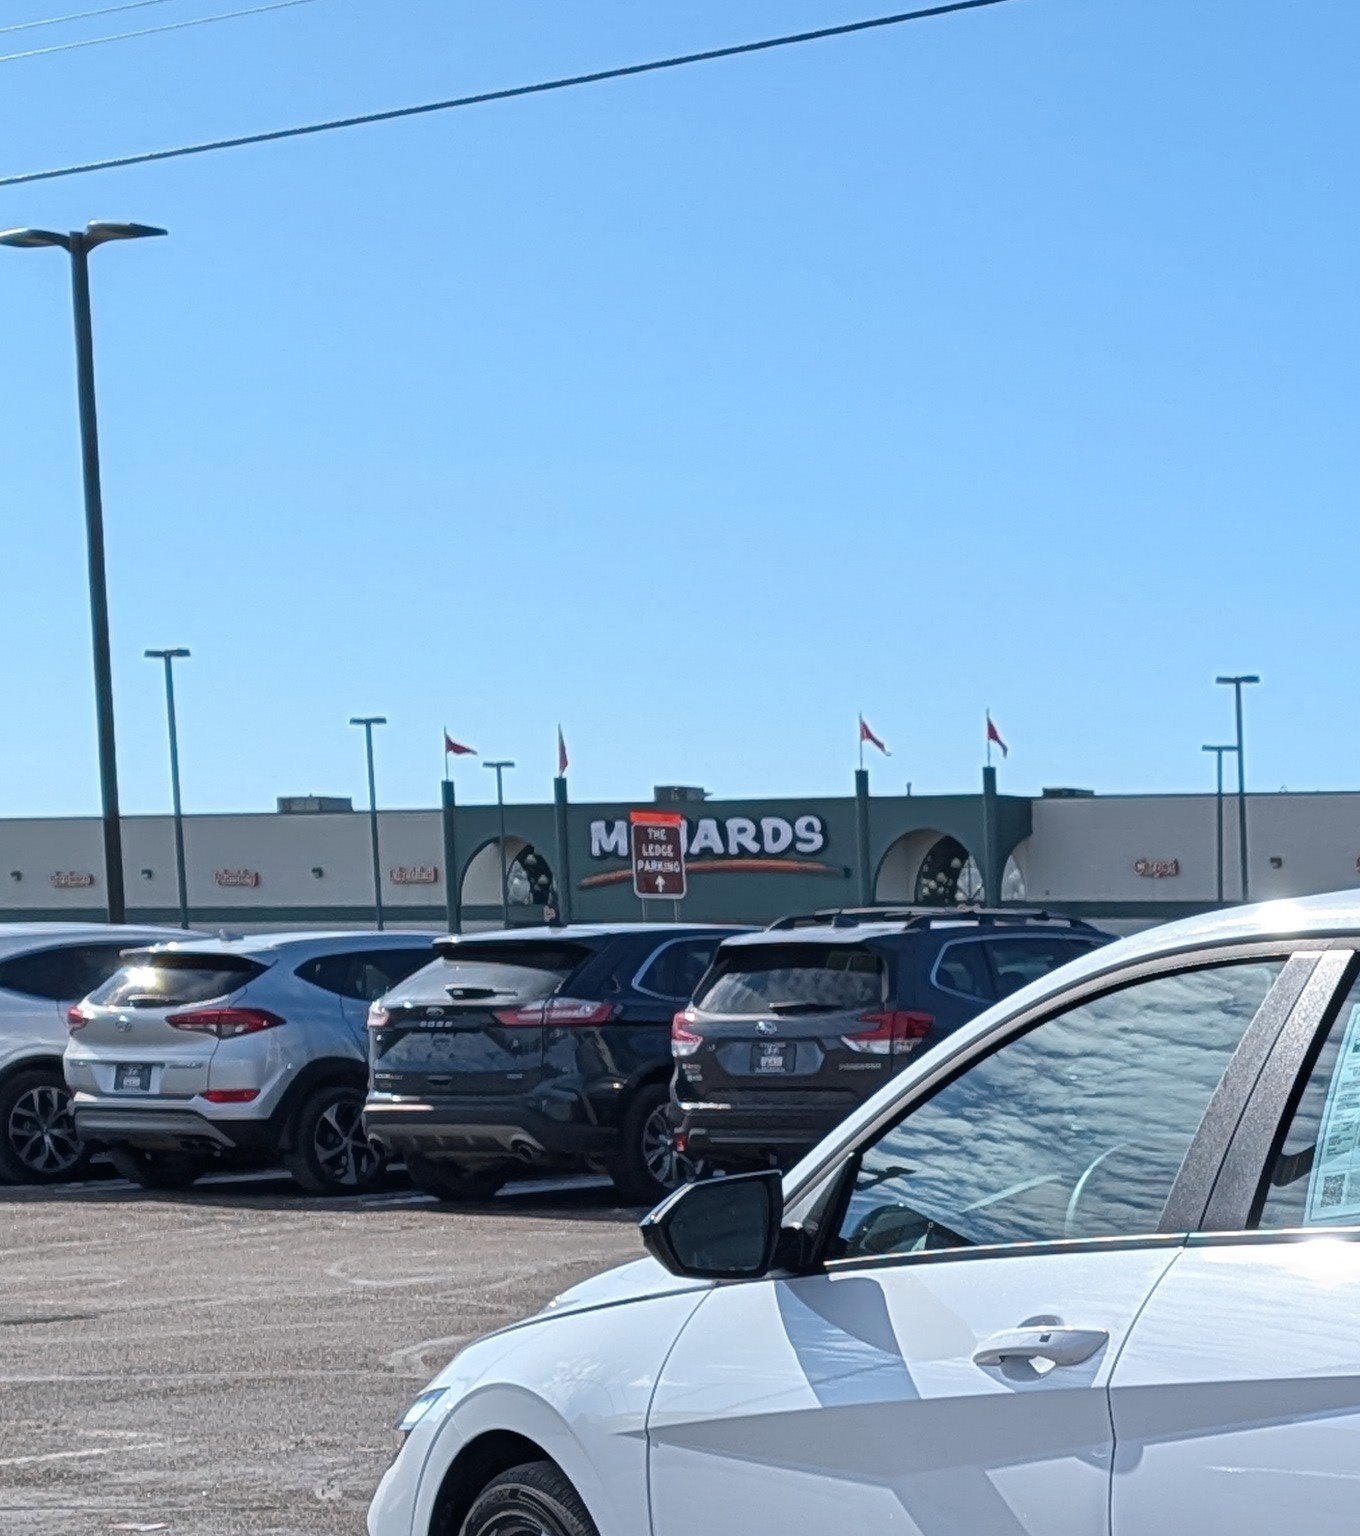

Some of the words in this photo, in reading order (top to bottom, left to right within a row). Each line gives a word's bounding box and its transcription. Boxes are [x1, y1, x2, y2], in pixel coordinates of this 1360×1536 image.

[590, 815, 825, 857] MARDS
[647, 828, 667, 841] THE
[641, 844, 674, 857] LEDGE
[637, 860, 680, 873] PARKING
